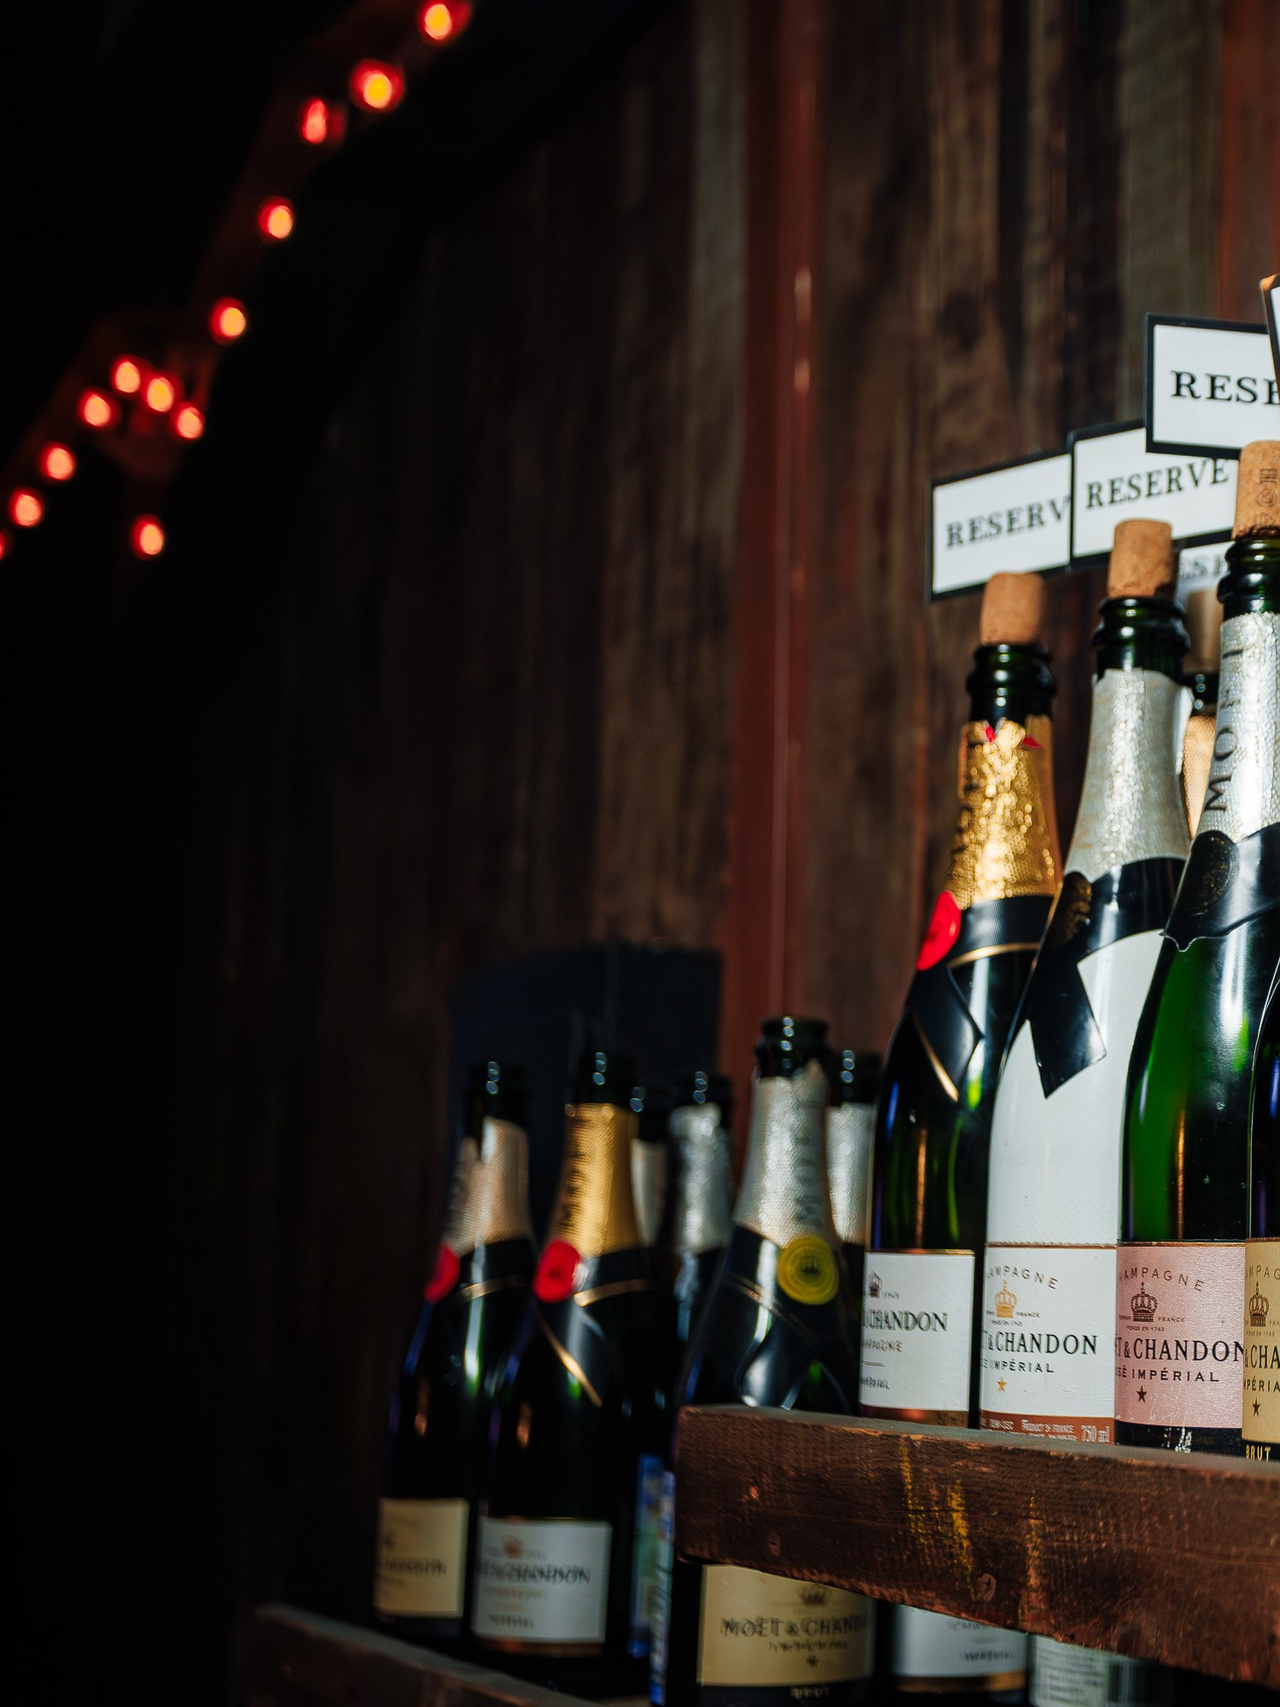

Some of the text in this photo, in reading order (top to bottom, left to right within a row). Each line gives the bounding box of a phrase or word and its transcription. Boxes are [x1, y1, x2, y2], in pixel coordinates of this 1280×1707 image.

[1086, 458, 1231, 509] RESERVE
[1119, 1266, 1205, 1293] AMPAGNE
[995, 1331, 1099, 1355] CHANDON
[1133, 1337, 1244, 1362] CHANDON
[1131, 1366, 1220, 1383] IMPÉRIAL
[1245, 1444, 1272, 1462] BRUT
